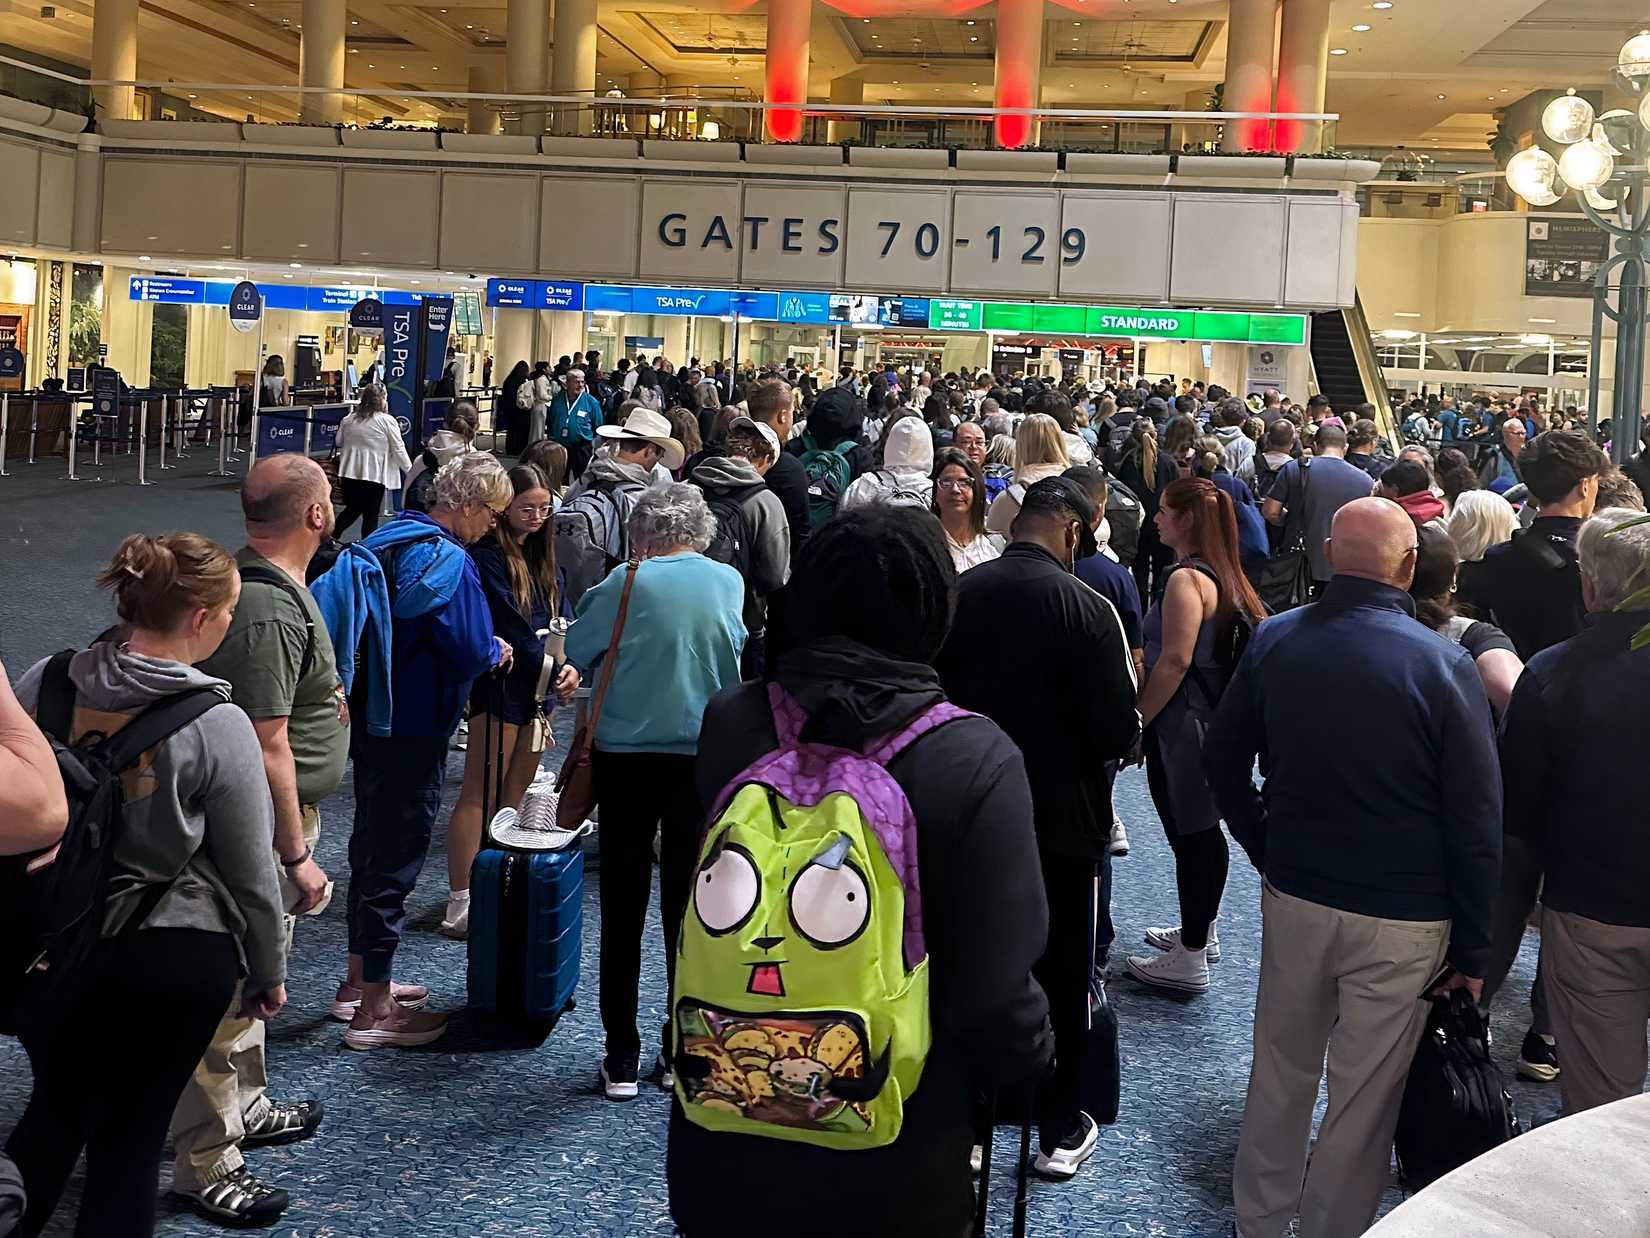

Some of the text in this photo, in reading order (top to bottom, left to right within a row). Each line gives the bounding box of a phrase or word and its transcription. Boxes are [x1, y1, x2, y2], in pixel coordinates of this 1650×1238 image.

[658, 213, 1087, 263] GATES 70-129
[656, 296, 692, 308] TSA Pre
[428, 305, 448, 314] Enter
[428, 312, 446, 320] Here
[1101, 315, 1178, 330] STANDARD
[391, 311, 410, 377] TSA Pre
[278, 428, 294, 436] CLEAR
